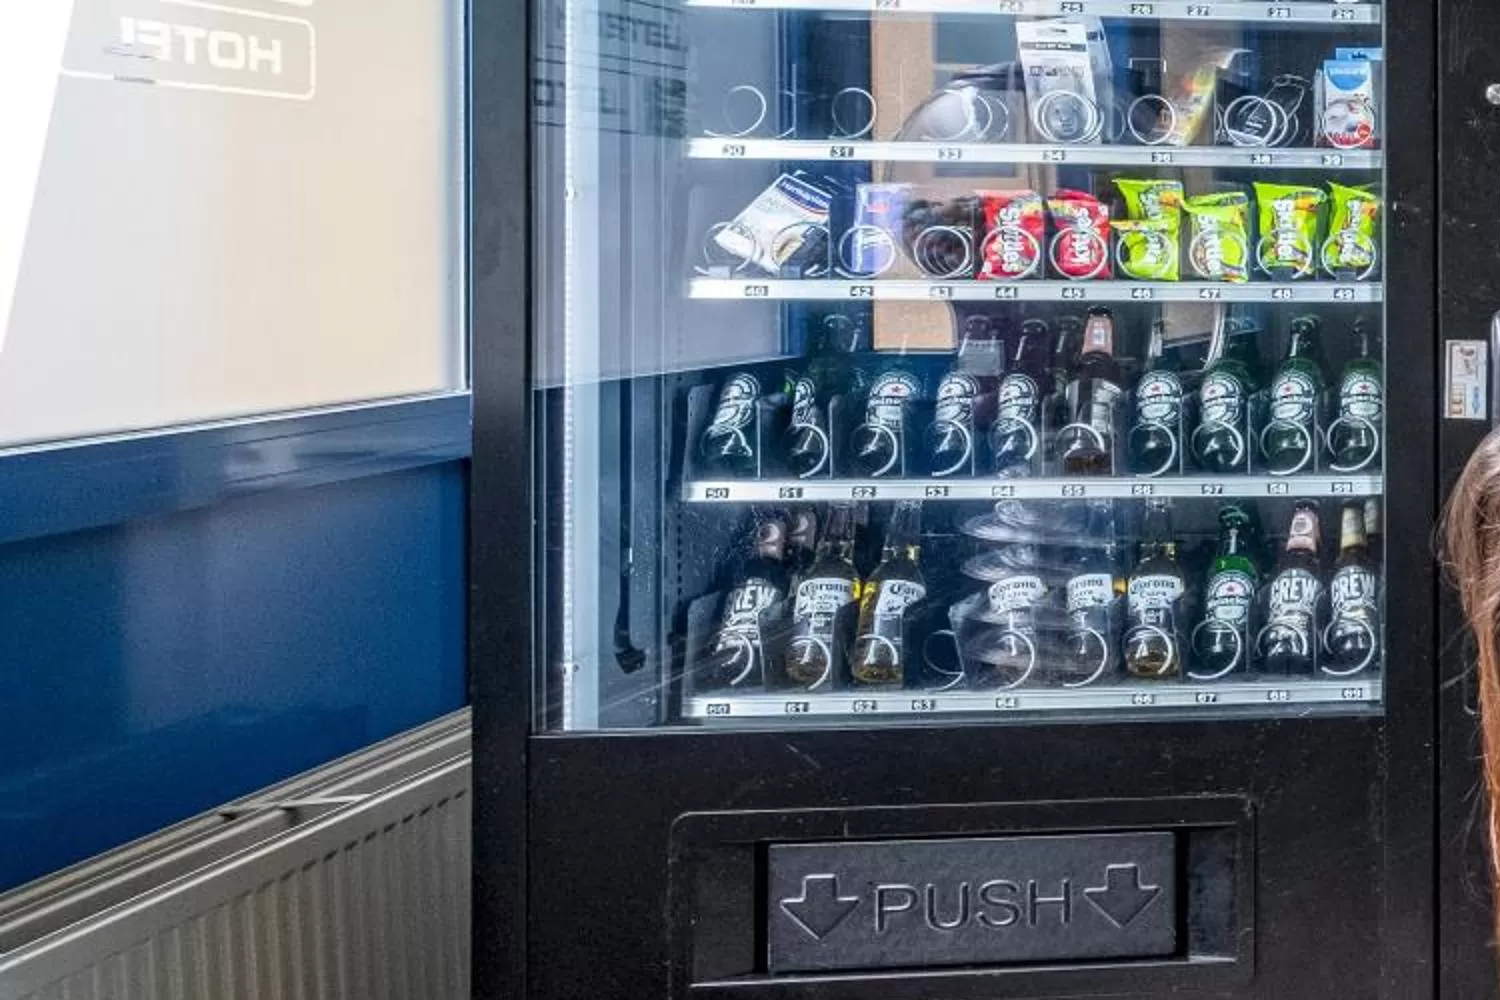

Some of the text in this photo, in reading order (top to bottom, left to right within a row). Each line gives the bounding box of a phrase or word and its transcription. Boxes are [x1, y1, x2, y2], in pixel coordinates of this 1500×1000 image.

[1271, 577, 1318, 602] CREW
[1331, 572, 1375, 601] CREW
[873, 878, 1073, 933] PUSH
